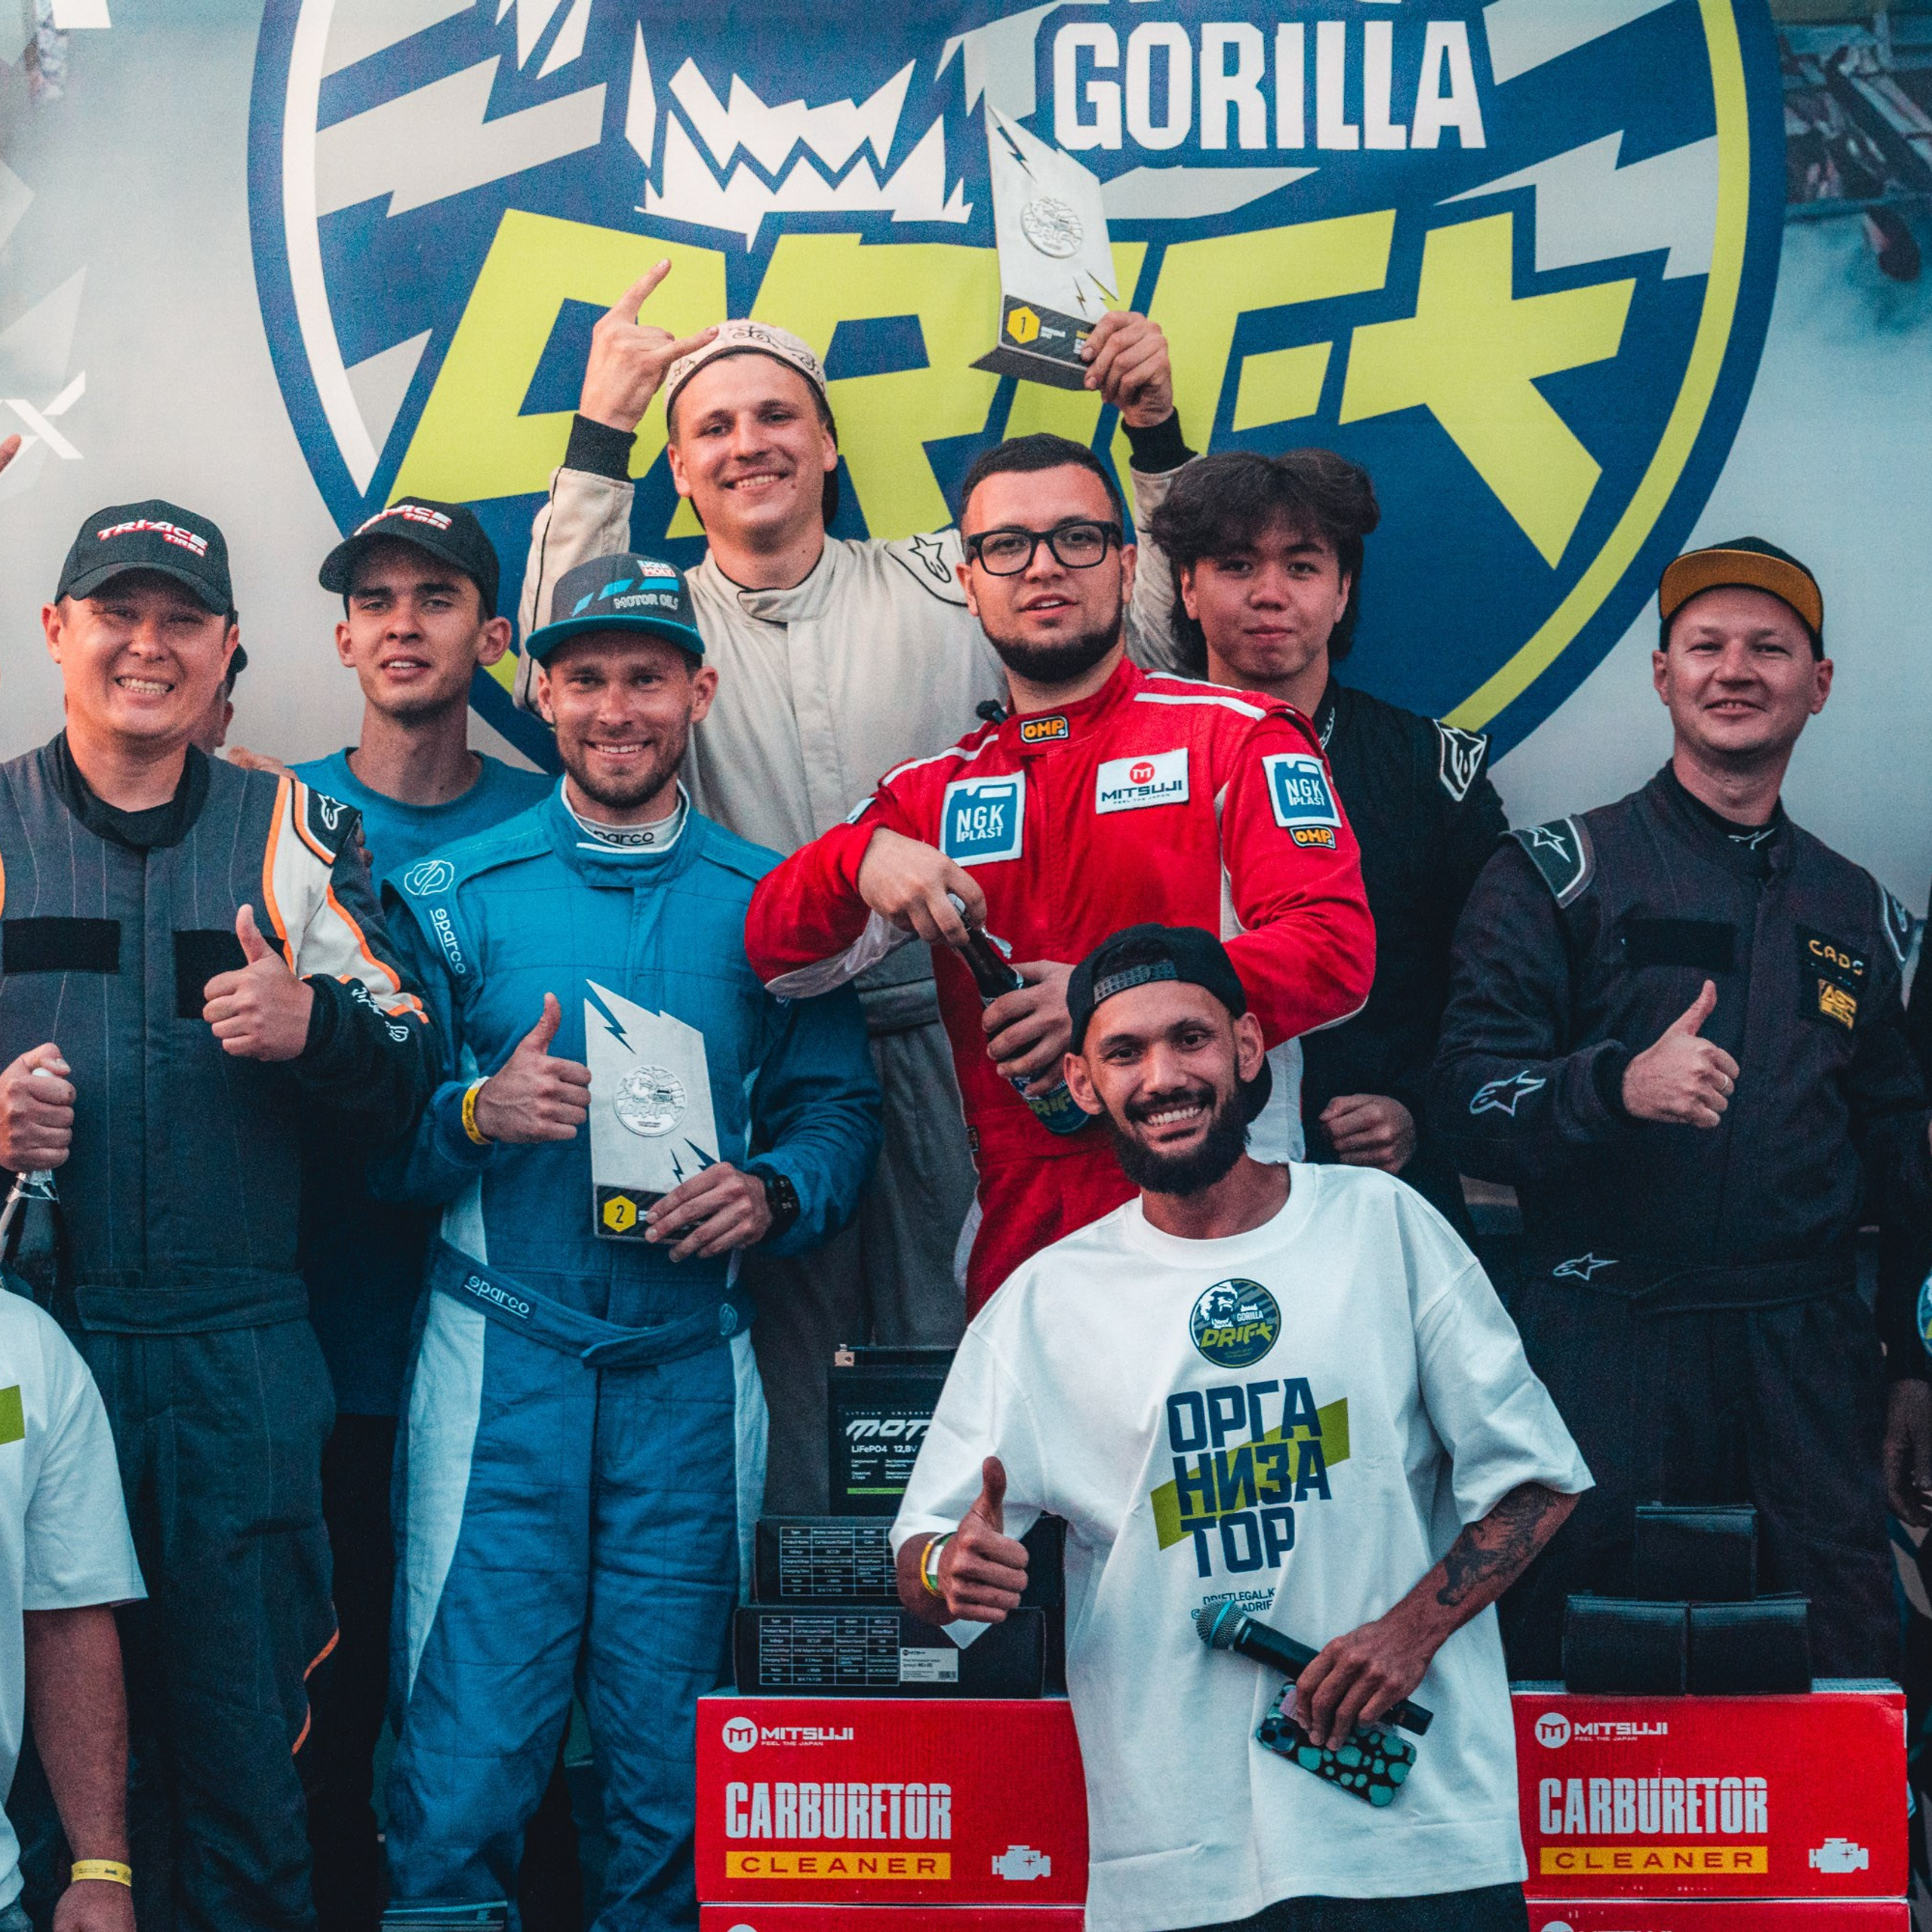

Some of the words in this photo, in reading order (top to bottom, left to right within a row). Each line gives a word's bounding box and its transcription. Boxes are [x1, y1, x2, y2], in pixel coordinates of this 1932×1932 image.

[1054, 20, 1487, 151] GORILLA
[1021, 317, 1026, 334] 1
[97, 518, 208, 552] TRI-ACE
[614, 593, 658, 609] MOTOR
[659, 594, 679, 611] OILS
[1024, 718, 1065, 739] OMP
[1101, 780, 1183, 802] MITSUJI
[1285, 778, 1324, 800] NGK
[1293, 796, 1325, 806] PLAST
[956, 804, 1005, 835] NGK
[593, 831, 654, 844] parco
[961, 826, 1004, 842] PLAST
[1295, 829, 1332, 844] OMP
[616, 1204, 624, 1223] 2
[1237, 1310, 1264, 1322] GORILLA
[1200, 1321, 1273, 1349] DRIFT
[1166, 1377, 1323, 1454] ОРГА
[846, 1419, 932, 1441] MOT
[1172, 1440, 1333, 1516] НИЗА
[1180, 1506, 1296, 1579] ТОР
[761, 1727, 854, 1740] MITSUJI
[1574, 1722, 1669, 1735] MITSUJI
[725, 1781, 952, 1840] CARBURETOR
[1539, 1777, 1768, 1835] CARBURETOR
[740, 1857, 937, 1874] CLEANER
[1555, 1852, 1753, 1869] CLEANER
